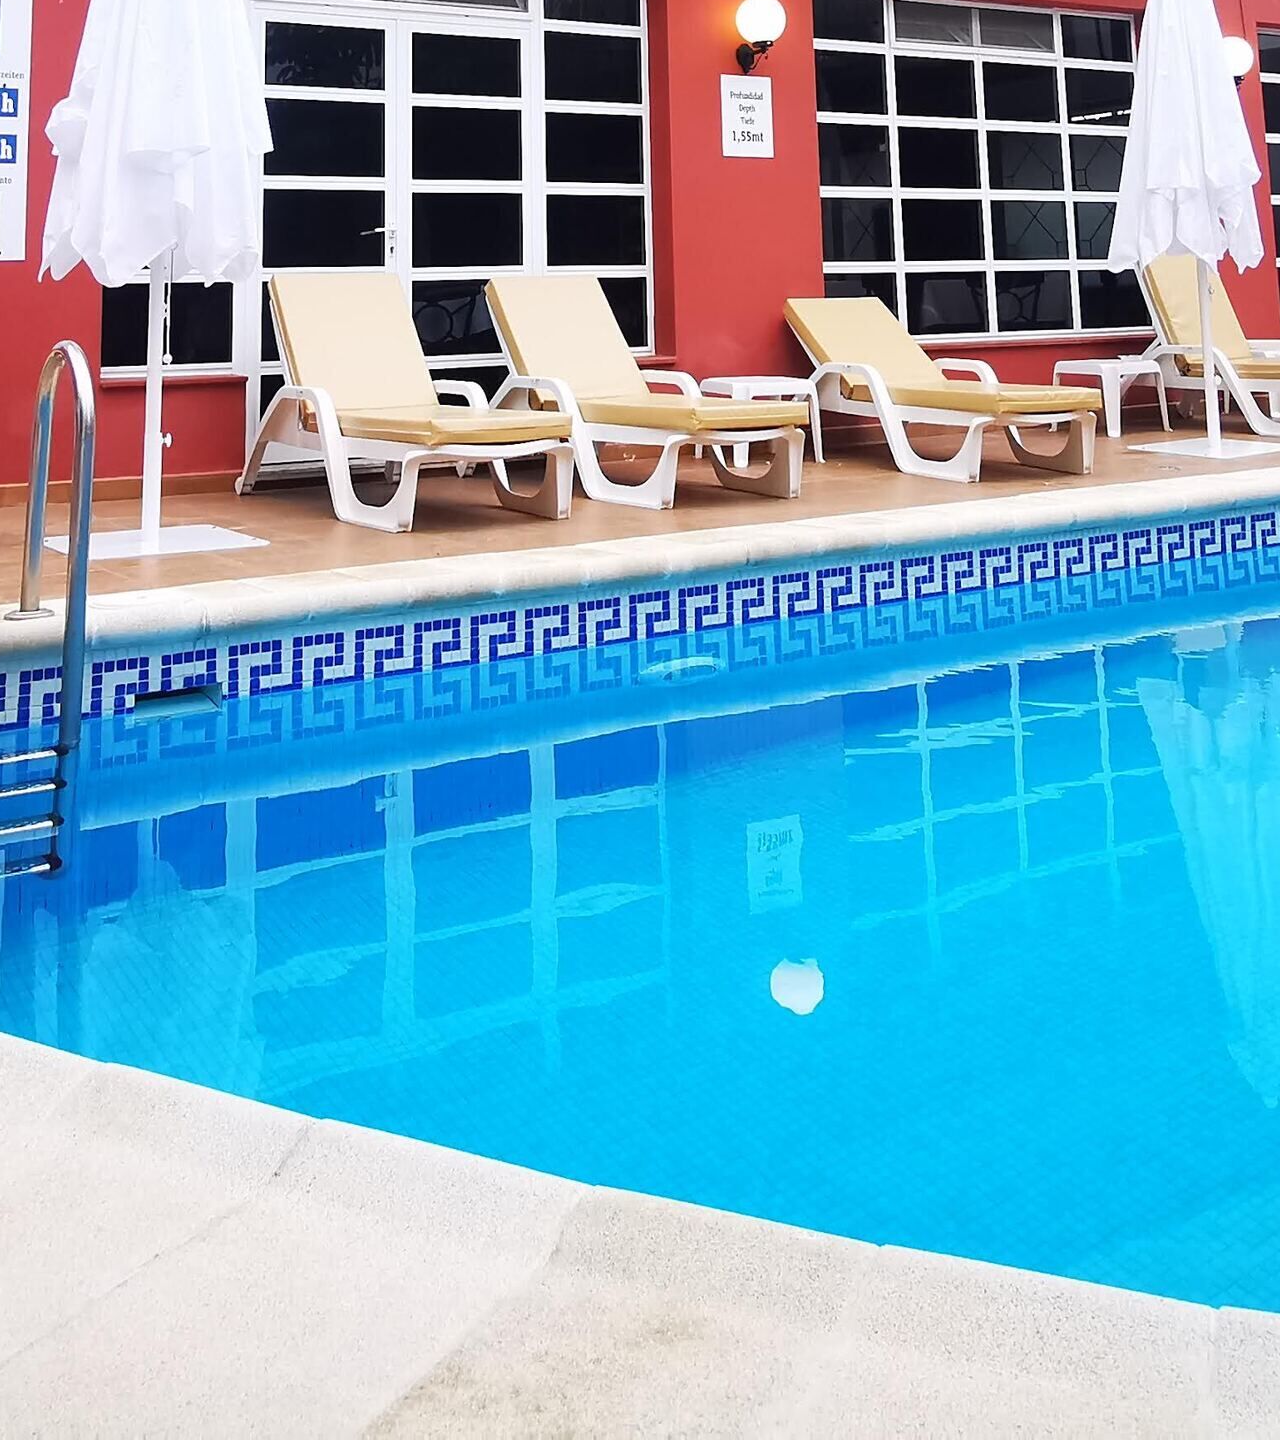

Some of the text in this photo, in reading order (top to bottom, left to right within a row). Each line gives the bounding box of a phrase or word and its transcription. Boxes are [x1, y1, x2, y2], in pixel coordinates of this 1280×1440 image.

[0, 91, 15, 113] h
[732, 130, 764, 143] 1,55mt
[0, 138, 13, 160] h
